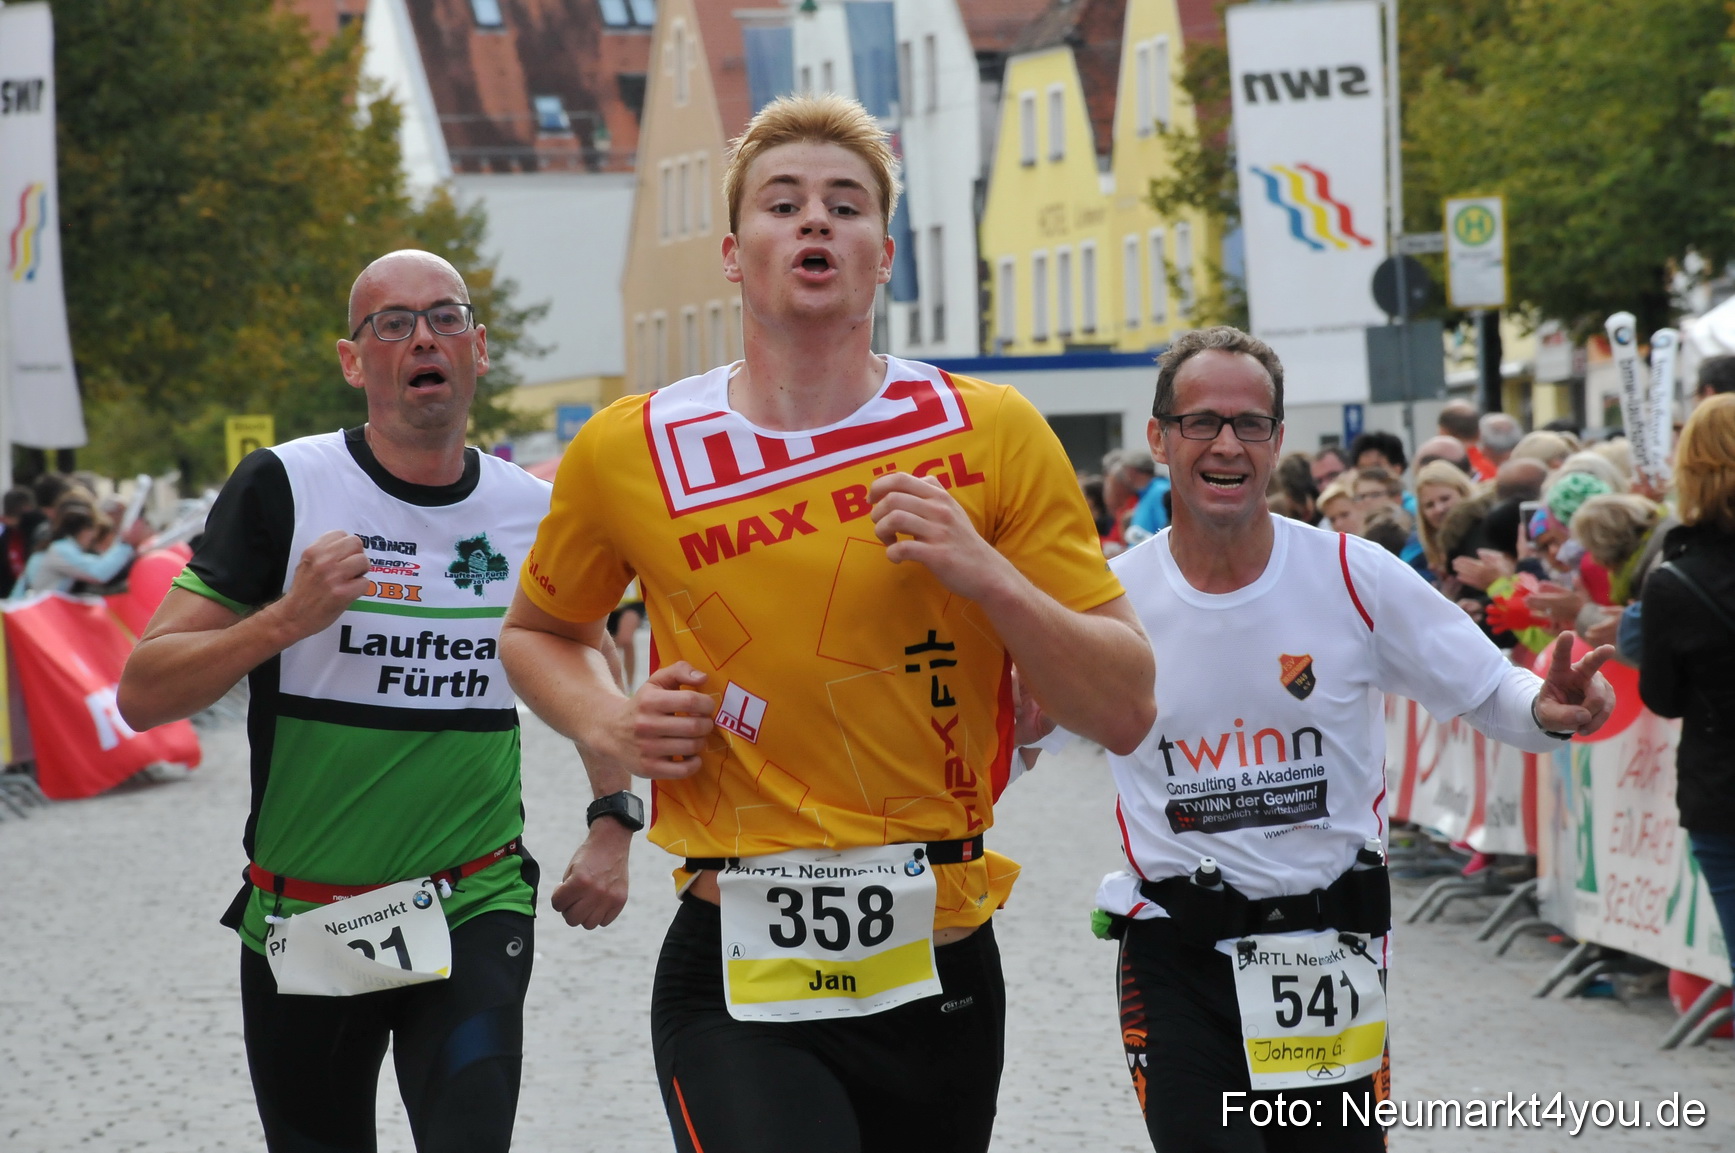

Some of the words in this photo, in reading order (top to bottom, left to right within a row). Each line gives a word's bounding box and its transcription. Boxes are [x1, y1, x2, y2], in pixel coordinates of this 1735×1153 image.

[679, 500, 819, 572] MAX
[831, 452, 985, 524] BGL
[368, 558, 408, 568] NERGY
[339, 625, 502, 660] Lauftea
[377, 665, 490, 697] Fürth
[1158, 718, 1323, 776] twinn
[1166, 776, 1236, 795] Consulting
[1241, 772, 1253, 787] &
[1256, 764, 1325, 785] Akademie
[1179, 797, 1231, 813] TWINN
[1235, 794, 1260, 808] der
[1263, 786, 1318, 805] Gewinn!
[1202, 808, 1252, 825] persönlich
[325, 901, 408, 936] Neumarkt
[767, 885, 895, 951] 358
[732, 945, 741, 957] A
[809, 970, 857, 992] Jan
[1272, 970, 1360, 1029] 541
[1254, 1040, 1326, 1062] Johann
[1317, 1065, 1334, 1077] A
